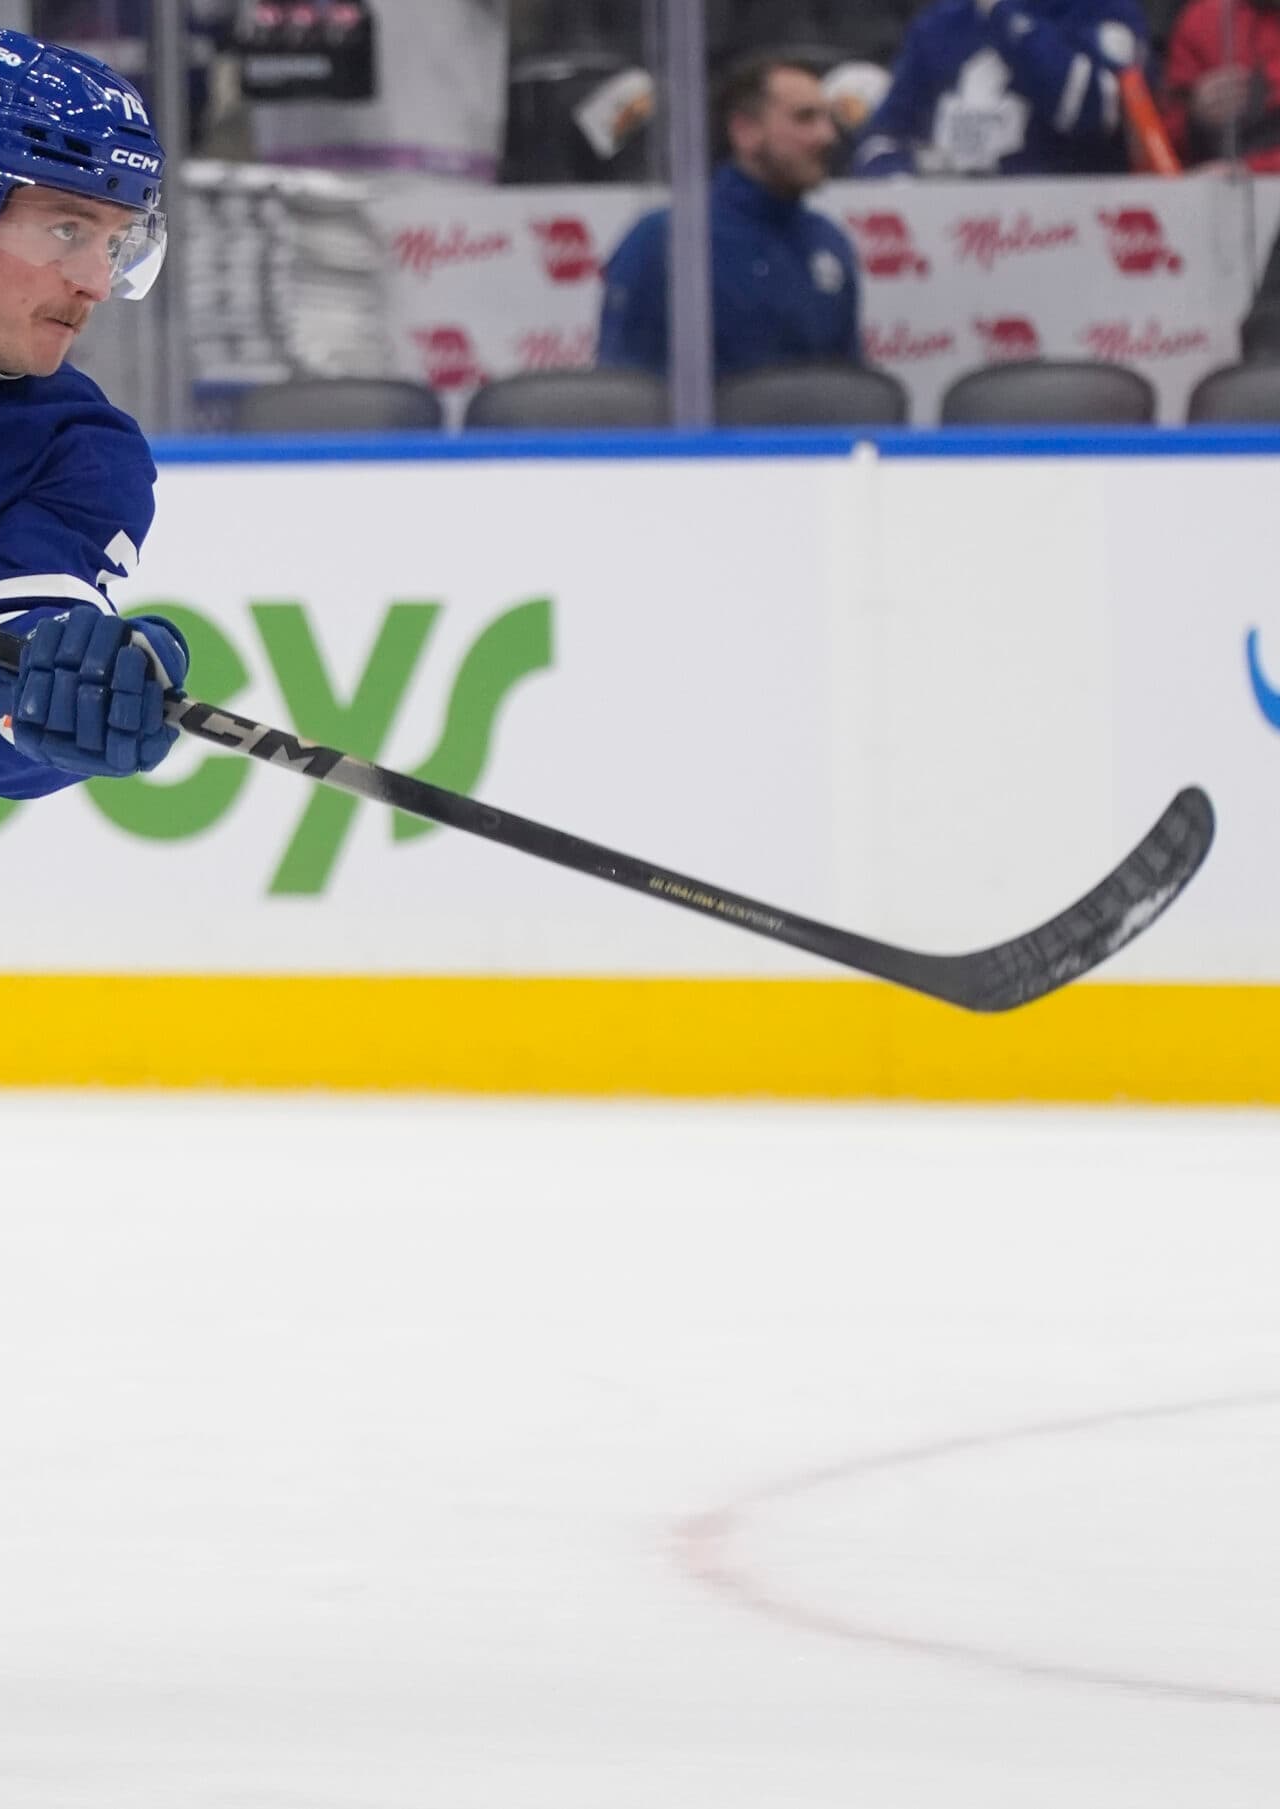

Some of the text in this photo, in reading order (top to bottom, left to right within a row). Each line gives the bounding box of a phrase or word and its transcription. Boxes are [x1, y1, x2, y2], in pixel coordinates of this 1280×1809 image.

[105, 87, 150, 126] 74
[110, 148, 159, 173] CCM
[178, 702, 347, 781] CM
